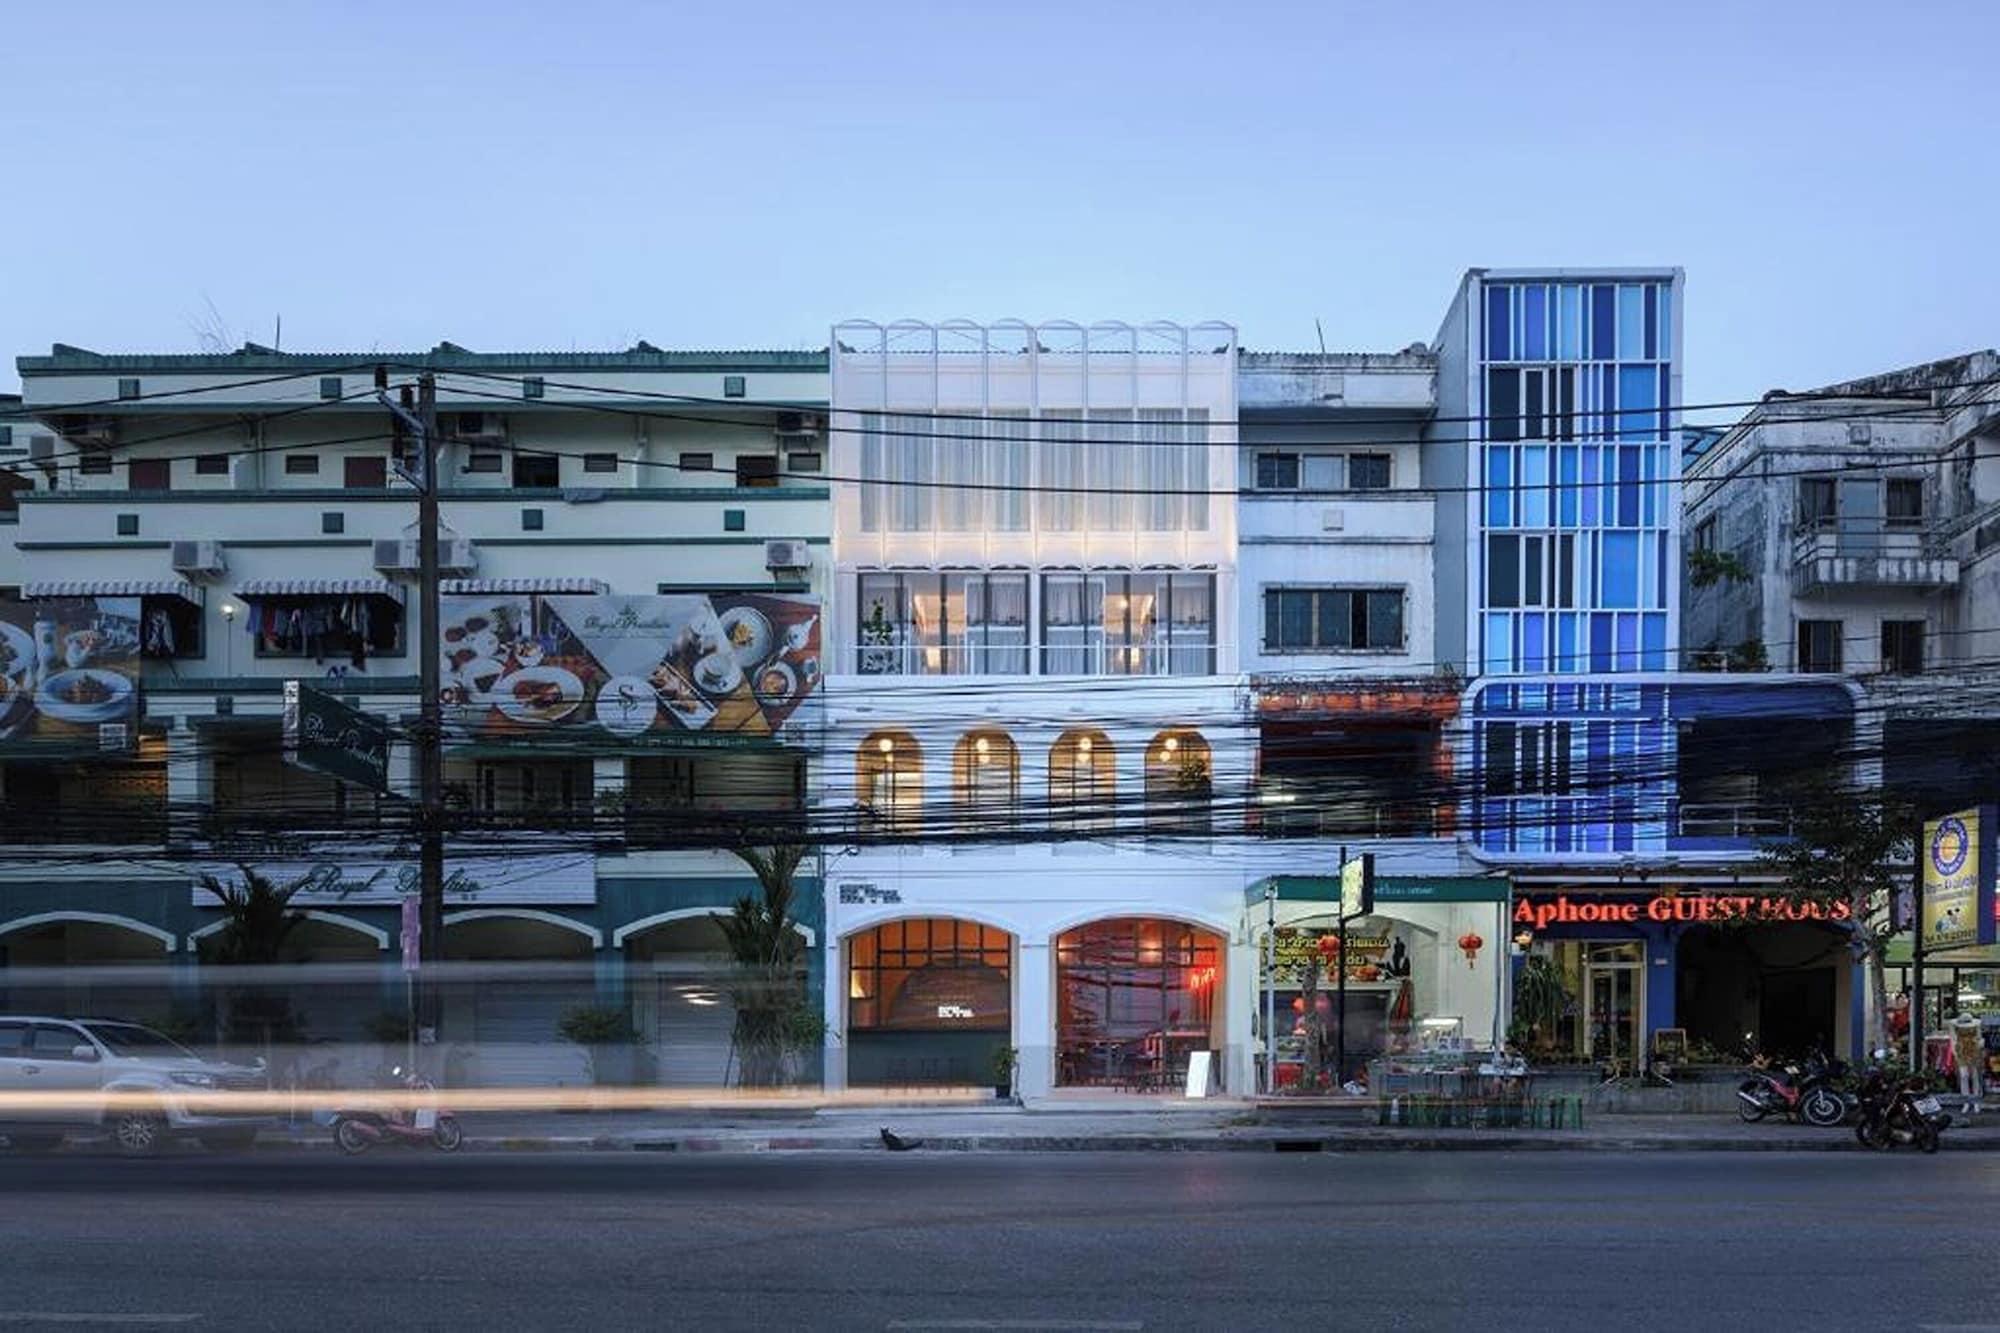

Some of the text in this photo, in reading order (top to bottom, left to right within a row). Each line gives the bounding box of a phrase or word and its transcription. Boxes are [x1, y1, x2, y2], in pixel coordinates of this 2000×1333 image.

[1514, 896, 1852, 928] Aphone GUEST HOUS
